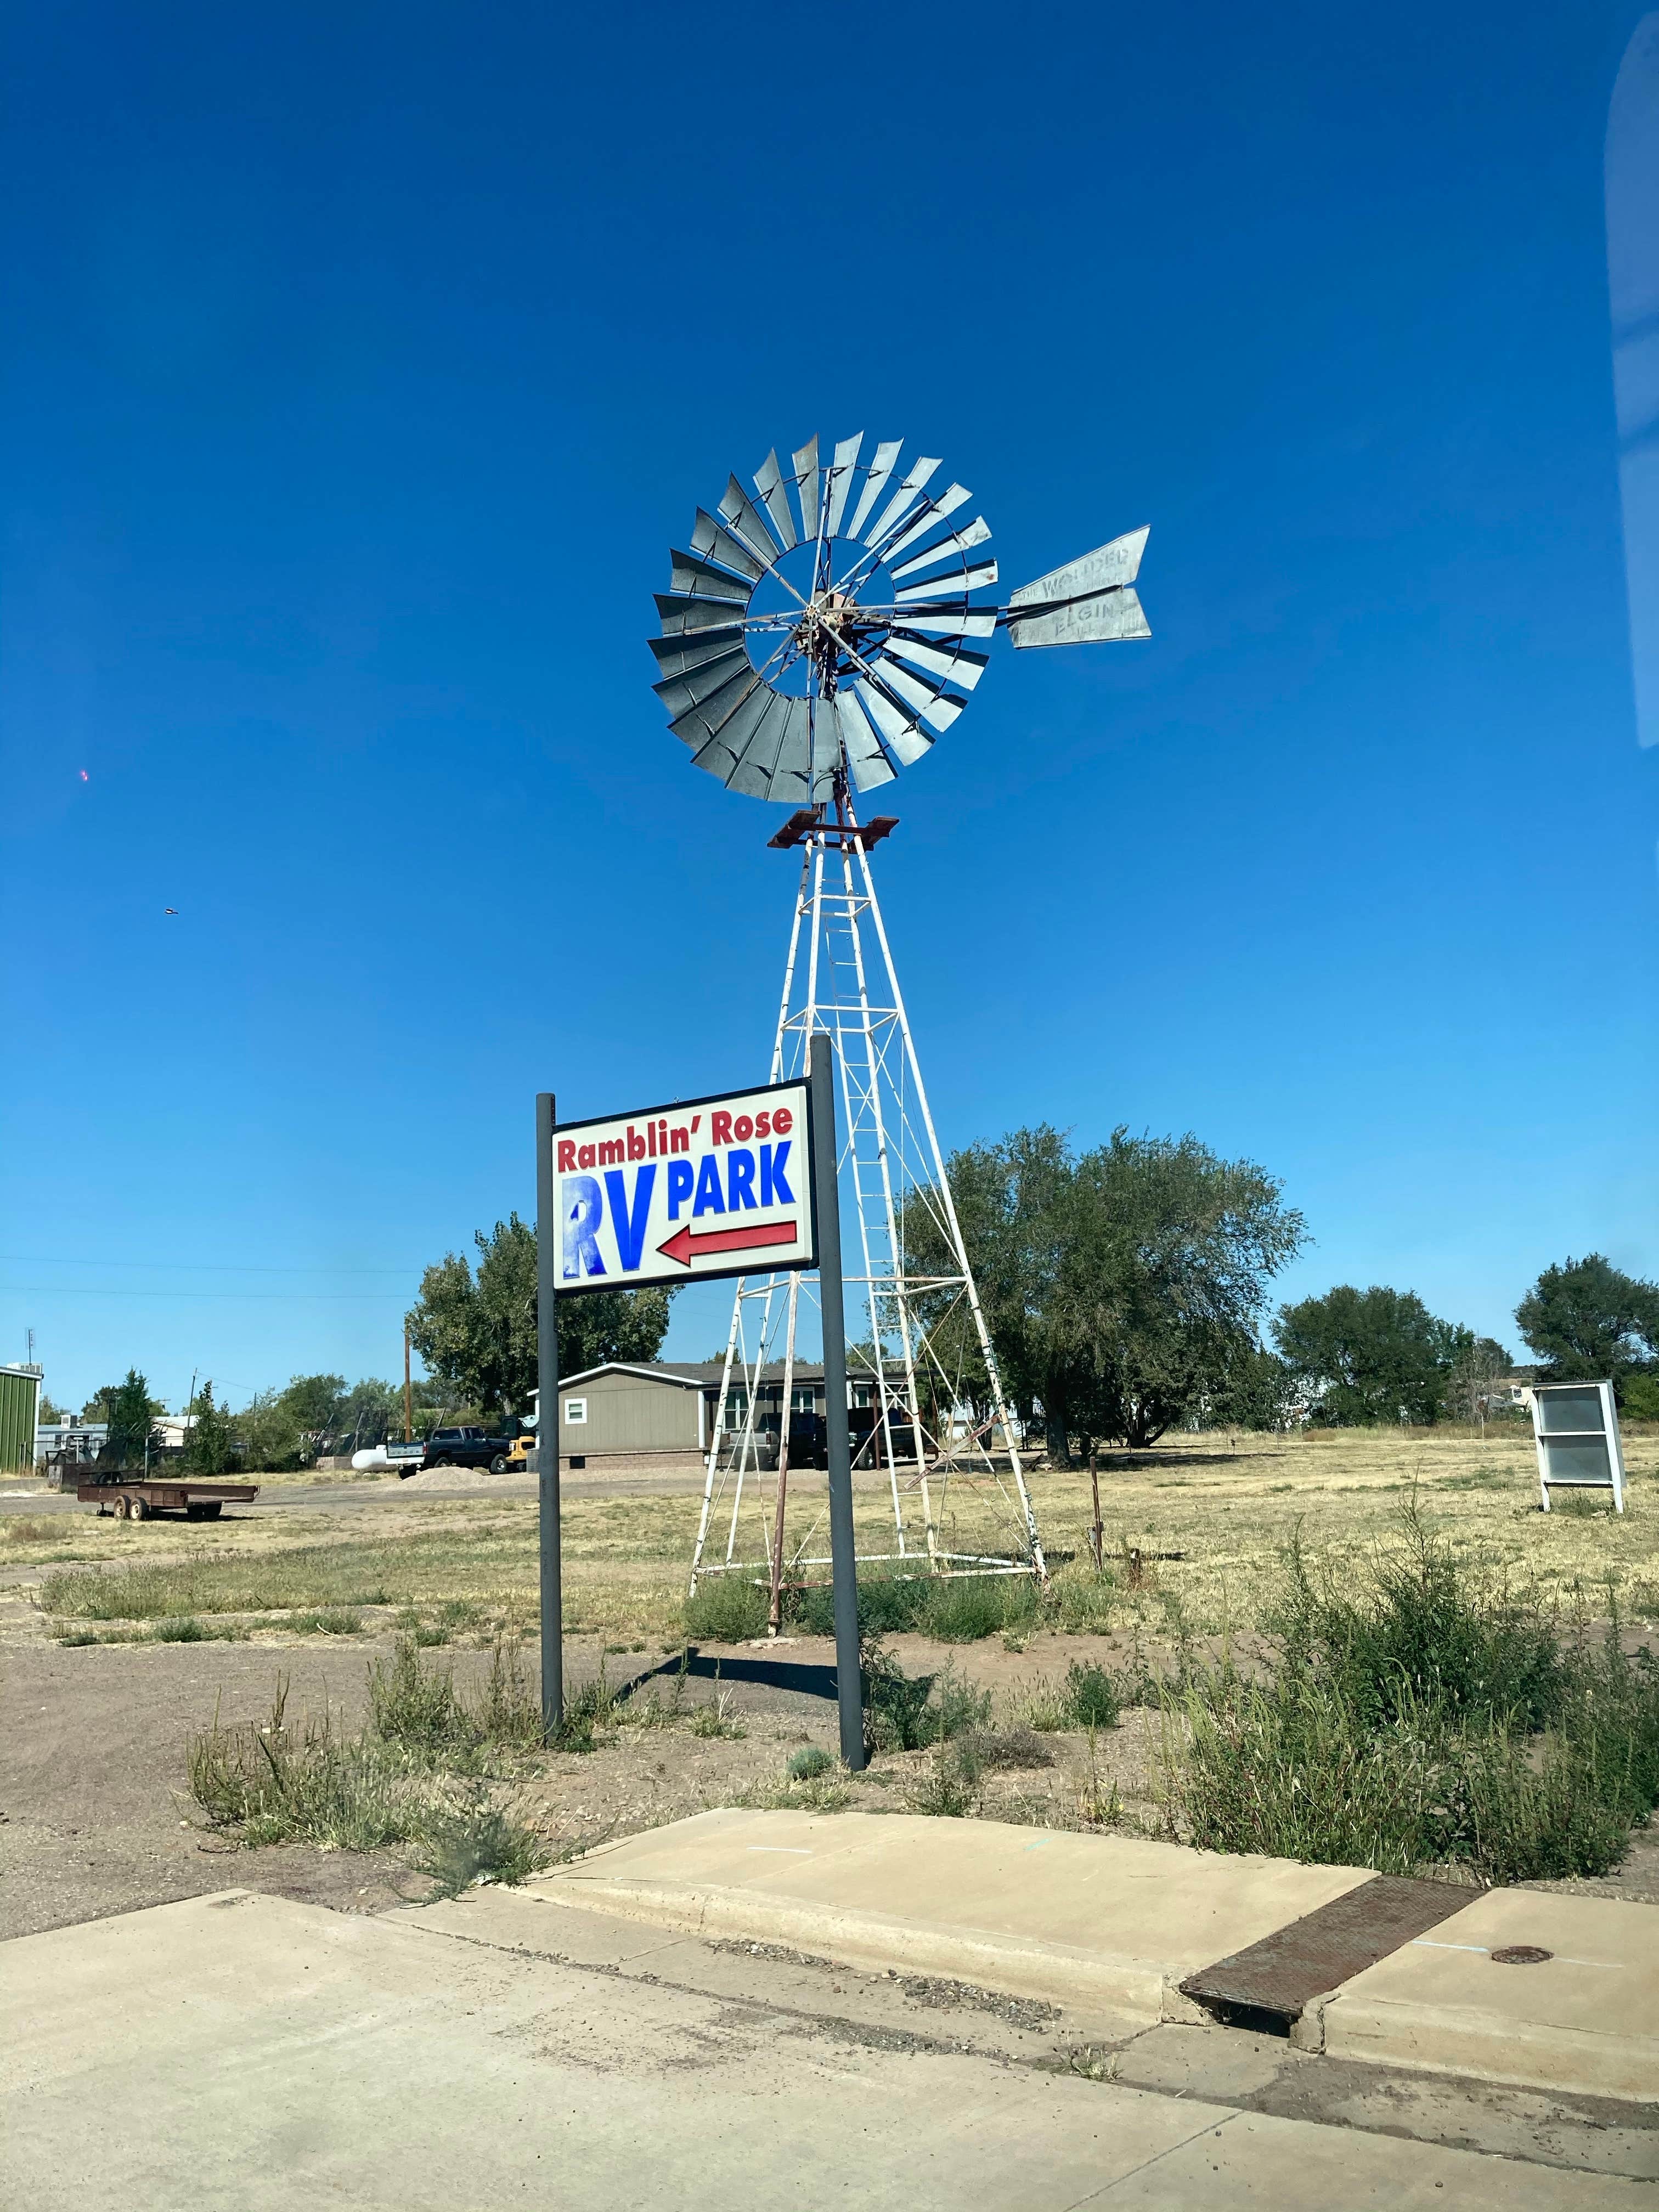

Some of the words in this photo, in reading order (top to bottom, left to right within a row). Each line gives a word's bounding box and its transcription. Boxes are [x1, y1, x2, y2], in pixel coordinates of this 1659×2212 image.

[557, 1115, 702, 1173] Ramblin'
[712, 1107, 793, 1146] Rose
[562, 1163, 657, 1280] RV
[668, 1140, 797, 1221] PARK
